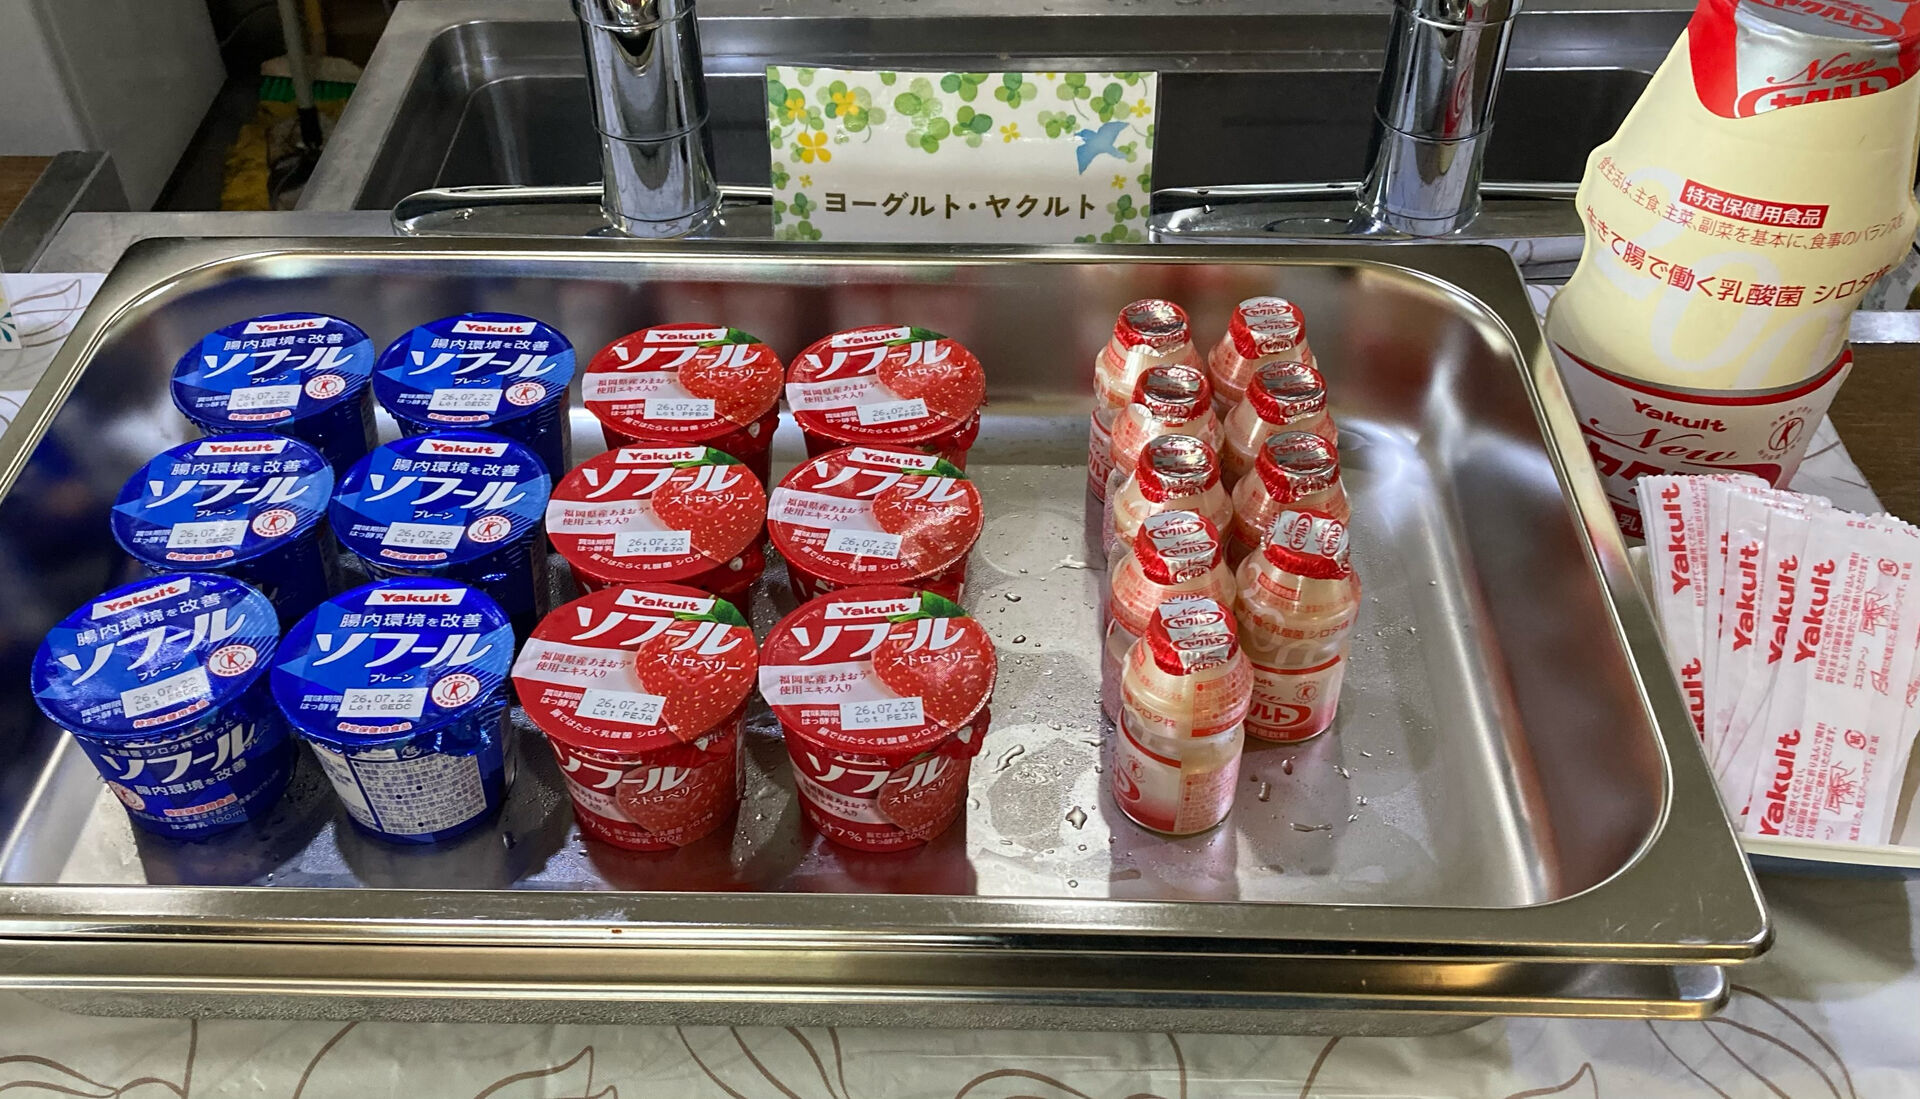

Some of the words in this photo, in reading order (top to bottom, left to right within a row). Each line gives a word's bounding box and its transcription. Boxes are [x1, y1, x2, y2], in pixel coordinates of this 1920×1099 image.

[1767, 53, 1877, 84] New
[824, 191, 1096, 219] ヨーグルト・ヤクルト
[1685, 185, 1821, 225] 特定保健用食品
[256, 322, 317, 332] Yakult
[465, 324, 525, 333] Yakult
[224, 333, 343, 350] 腸内環境を改善
[431, 339, 549, 351] 腸内環境を改善
[844, 331, 902, 344] Yakult
[203, 347, 353, 379] ソフール
[408, 351, 557, 377] ソフール
[613, 343, 761, 369] ソフール
[805, 341, 951, 378] ソフール
[695, 369, 769, 378] ストロベリー
[894, 364, 966, 378] ストロベリー
[238, 391, 290, 402] 26.07.22
[442, 393, 493, 401] 26.07.22
[872, 404, 923, 416] 26.07.23
[1632, 398, 1728, 432] Yakult
[210, 440, 274, 453] Yakult
[1589, 418, 1738, 462] New
[432, 443, 495, 455] Yakult
[628, 451, 695, 461] Yakult
[171, 460, 301, 475] 腸内環境を改善
[862, 452, 925, 467] Yakult
[392, 459, 520, 477] 腸内環境を改善
[582, 465, 743, 498] ソフール
[812, 461, 967, 502] ソフール
[146, 477, 309, 508] ソフール
[365, 474, 526, 510] ソフール
[671, 494, 750, 504] ストロベリー
[196, 509, 236, 517] プレーン
[414, 510, 454, 519] プレーン
[783, 507, 848, 521] 使用エキス入り
[180, 528, 235, 538] 26.07.22
[397, 529, 453, 540] 26.07.22
[1158, 527, 1193, 537] ヤクルト
[1661, 482, 1691, 595] Yakult
[628, 538, 684, 546] 26.07.23
[842, 537, 897, 550] 26.07.23
[104, 586, 181, 613] Yakult
[381, 593, 452, 603] Yakult
[632, 594, 700, 611] Yakult
[1732, 540, 1760, 651] Yakult
[838, 603, 910, 615] Yakult
[1768, 554, 1799, 665] Yakult
[1794, 559, 1835, 663] Yakult
[76, 593, 221, 646] 腸内環境を改善
[340, 614, 483, 628] 腸内環境を改善
[1174, 618, 1213, 627] ヤクルト
[571, 606, 742, 655] ソフール
[59, 608, 246, 686] ソフール
[791, 618, 965, 661] ソフール
[1184, 638, 1223, 647] ヤクルト
[312, 633, 492, 669] ソフール
[891, 652, 978, 666] ストロベリー
[536, 662, 607, 678] 使用エキス入り
[654, 653, 741, 672] ストロベリー
[138, 661, 183, 681] プレーン
[370, 673, 414, 682] プレーン
[780, 684, 852, 695] 使用エキス入り
[352, 694, 413, 703] 26.07.22
[596, 698, 658, 713] 26.07.23
[855, 701, 915, 715] 26.07.23
[101, 723, 255, 783] ソフール
[551, 739, 691, 795] ソフール
[806, 752, 950, 793] ソフール
[134, 759, 247, 795] 腸内環境を改善
[1758, 729, 1801, 835] Yakult
[629, 783, 703, 806] ストロベリー
[889, 773, 955, 805] ストロベリー
